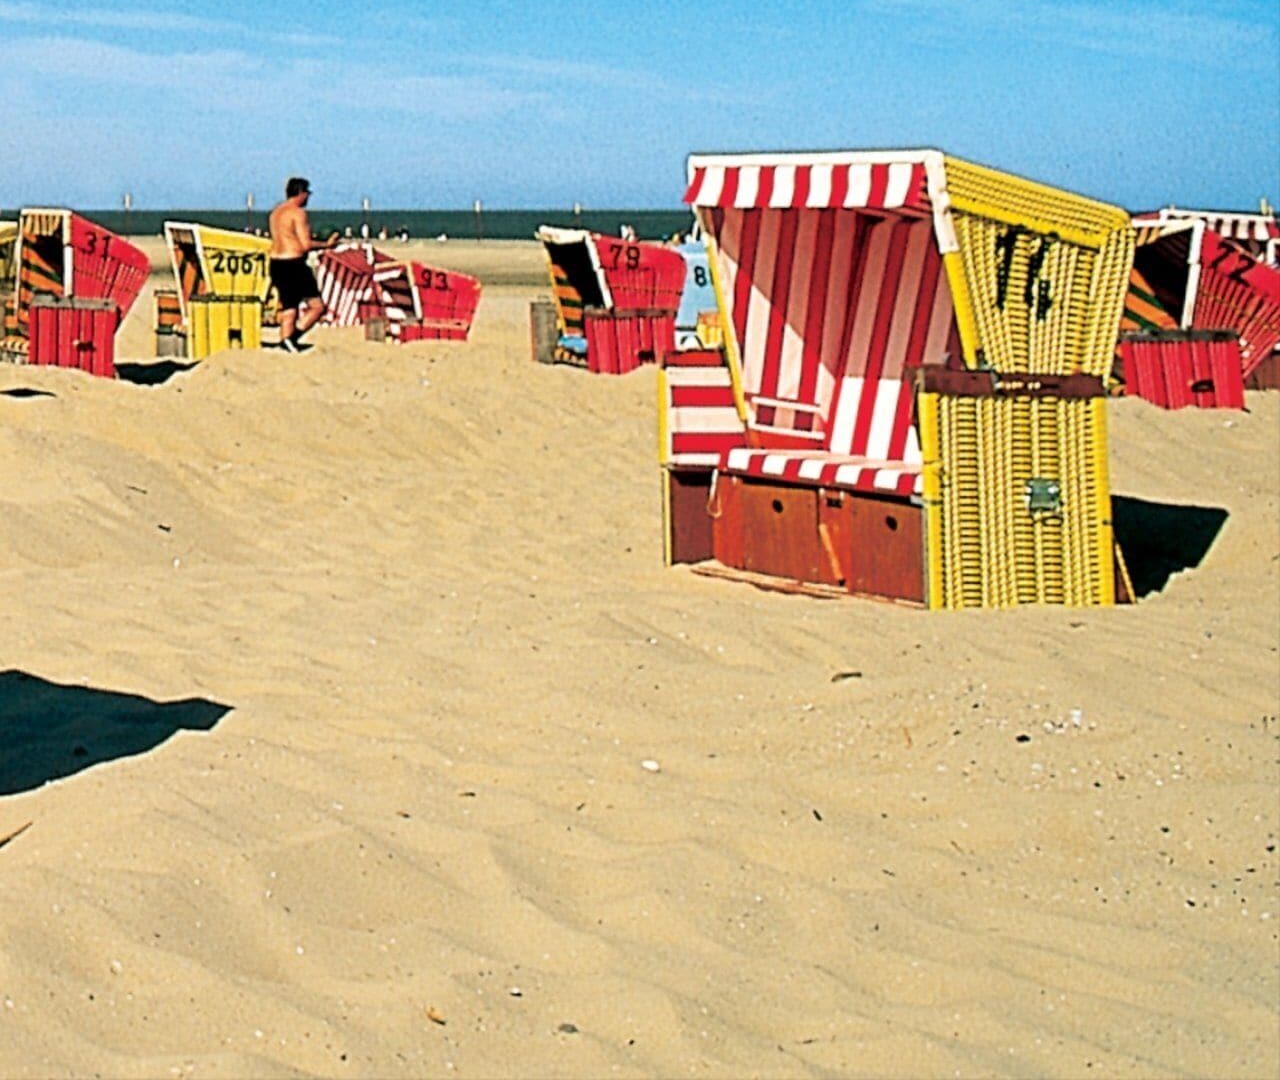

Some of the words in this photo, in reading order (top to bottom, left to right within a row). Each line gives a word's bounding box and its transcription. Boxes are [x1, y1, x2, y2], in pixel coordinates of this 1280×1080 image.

[82, 231, 111, 259] 31
[609, 244, 640, 270] 79
[209, 251, 266, 278] 2061
[1210, 240, 1257, 288] 72
[420, 268, 450, 291] 93
